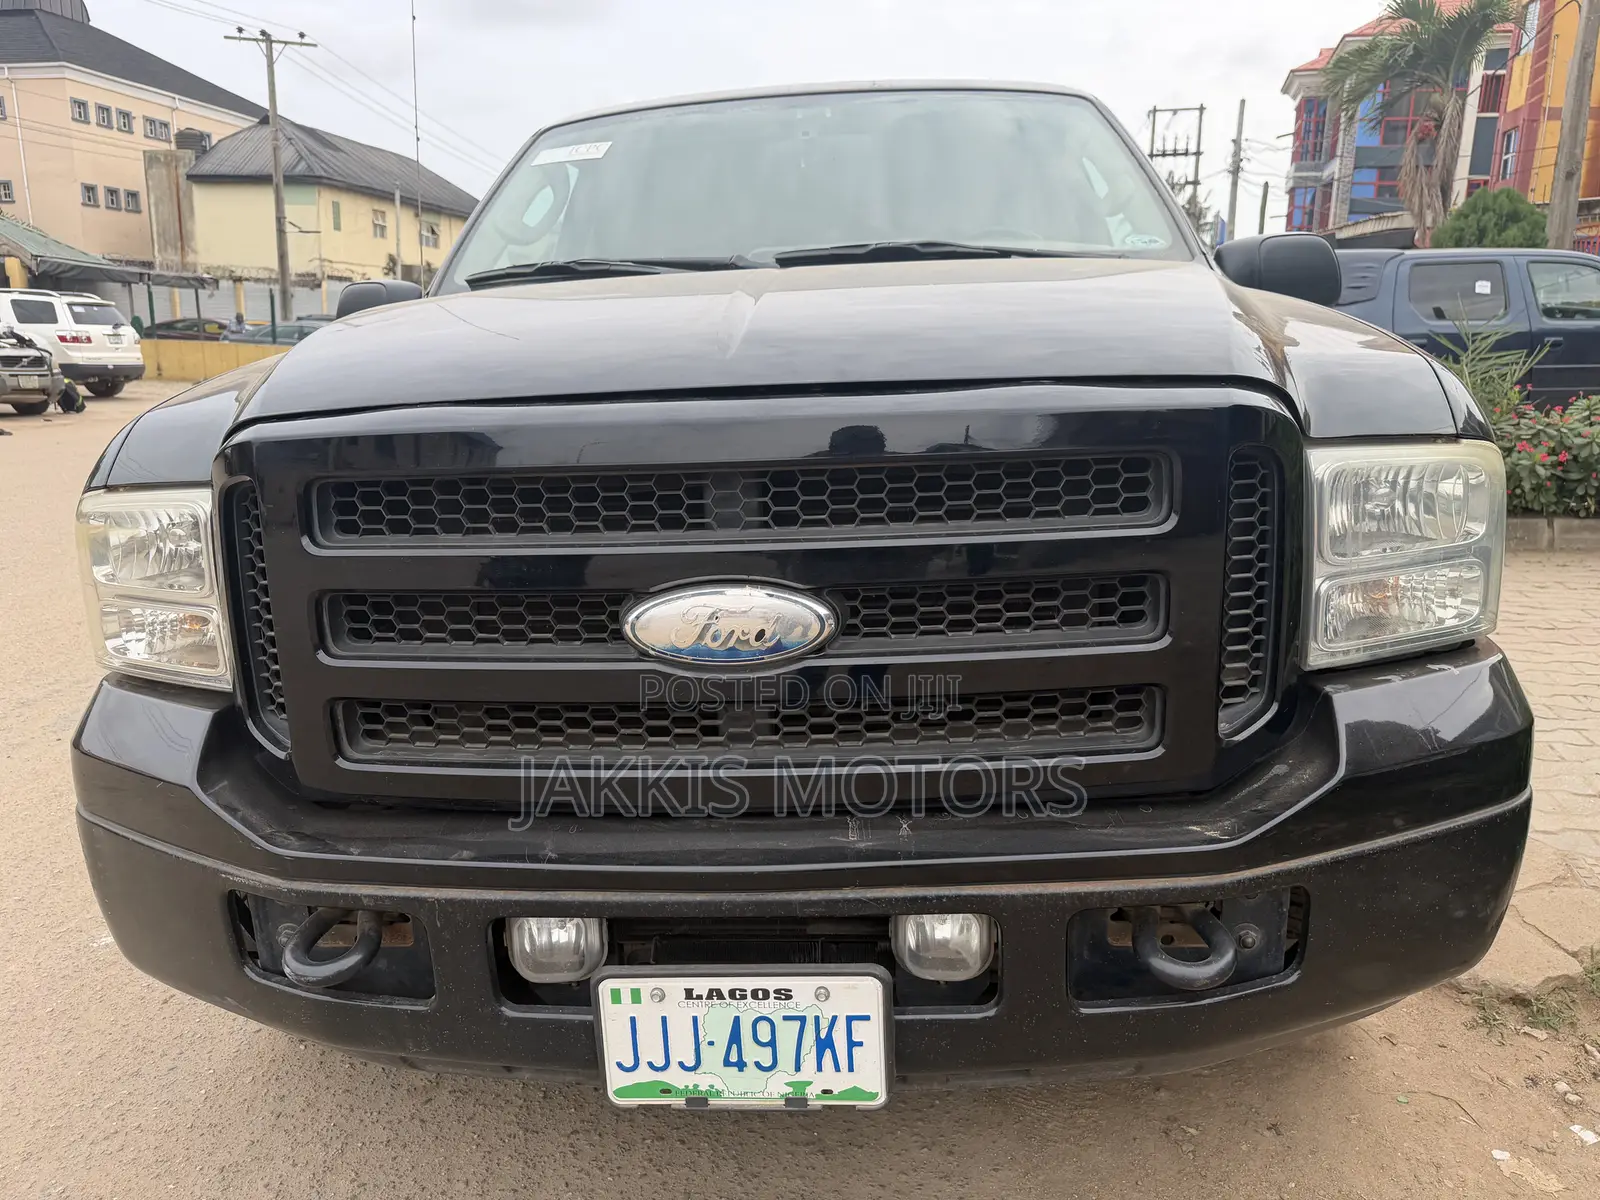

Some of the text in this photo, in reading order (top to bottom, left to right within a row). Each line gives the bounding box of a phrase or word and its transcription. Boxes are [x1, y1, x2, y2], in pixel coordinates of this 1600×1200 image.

[671, 603, 783, 651] Ford
[677, 1000, 801, 1010] CENTRE OF EXCELLENCE
[684, 988, 793, 1001] LAGOS
[615, 1014, 872, 1073] JJJ-497KF
